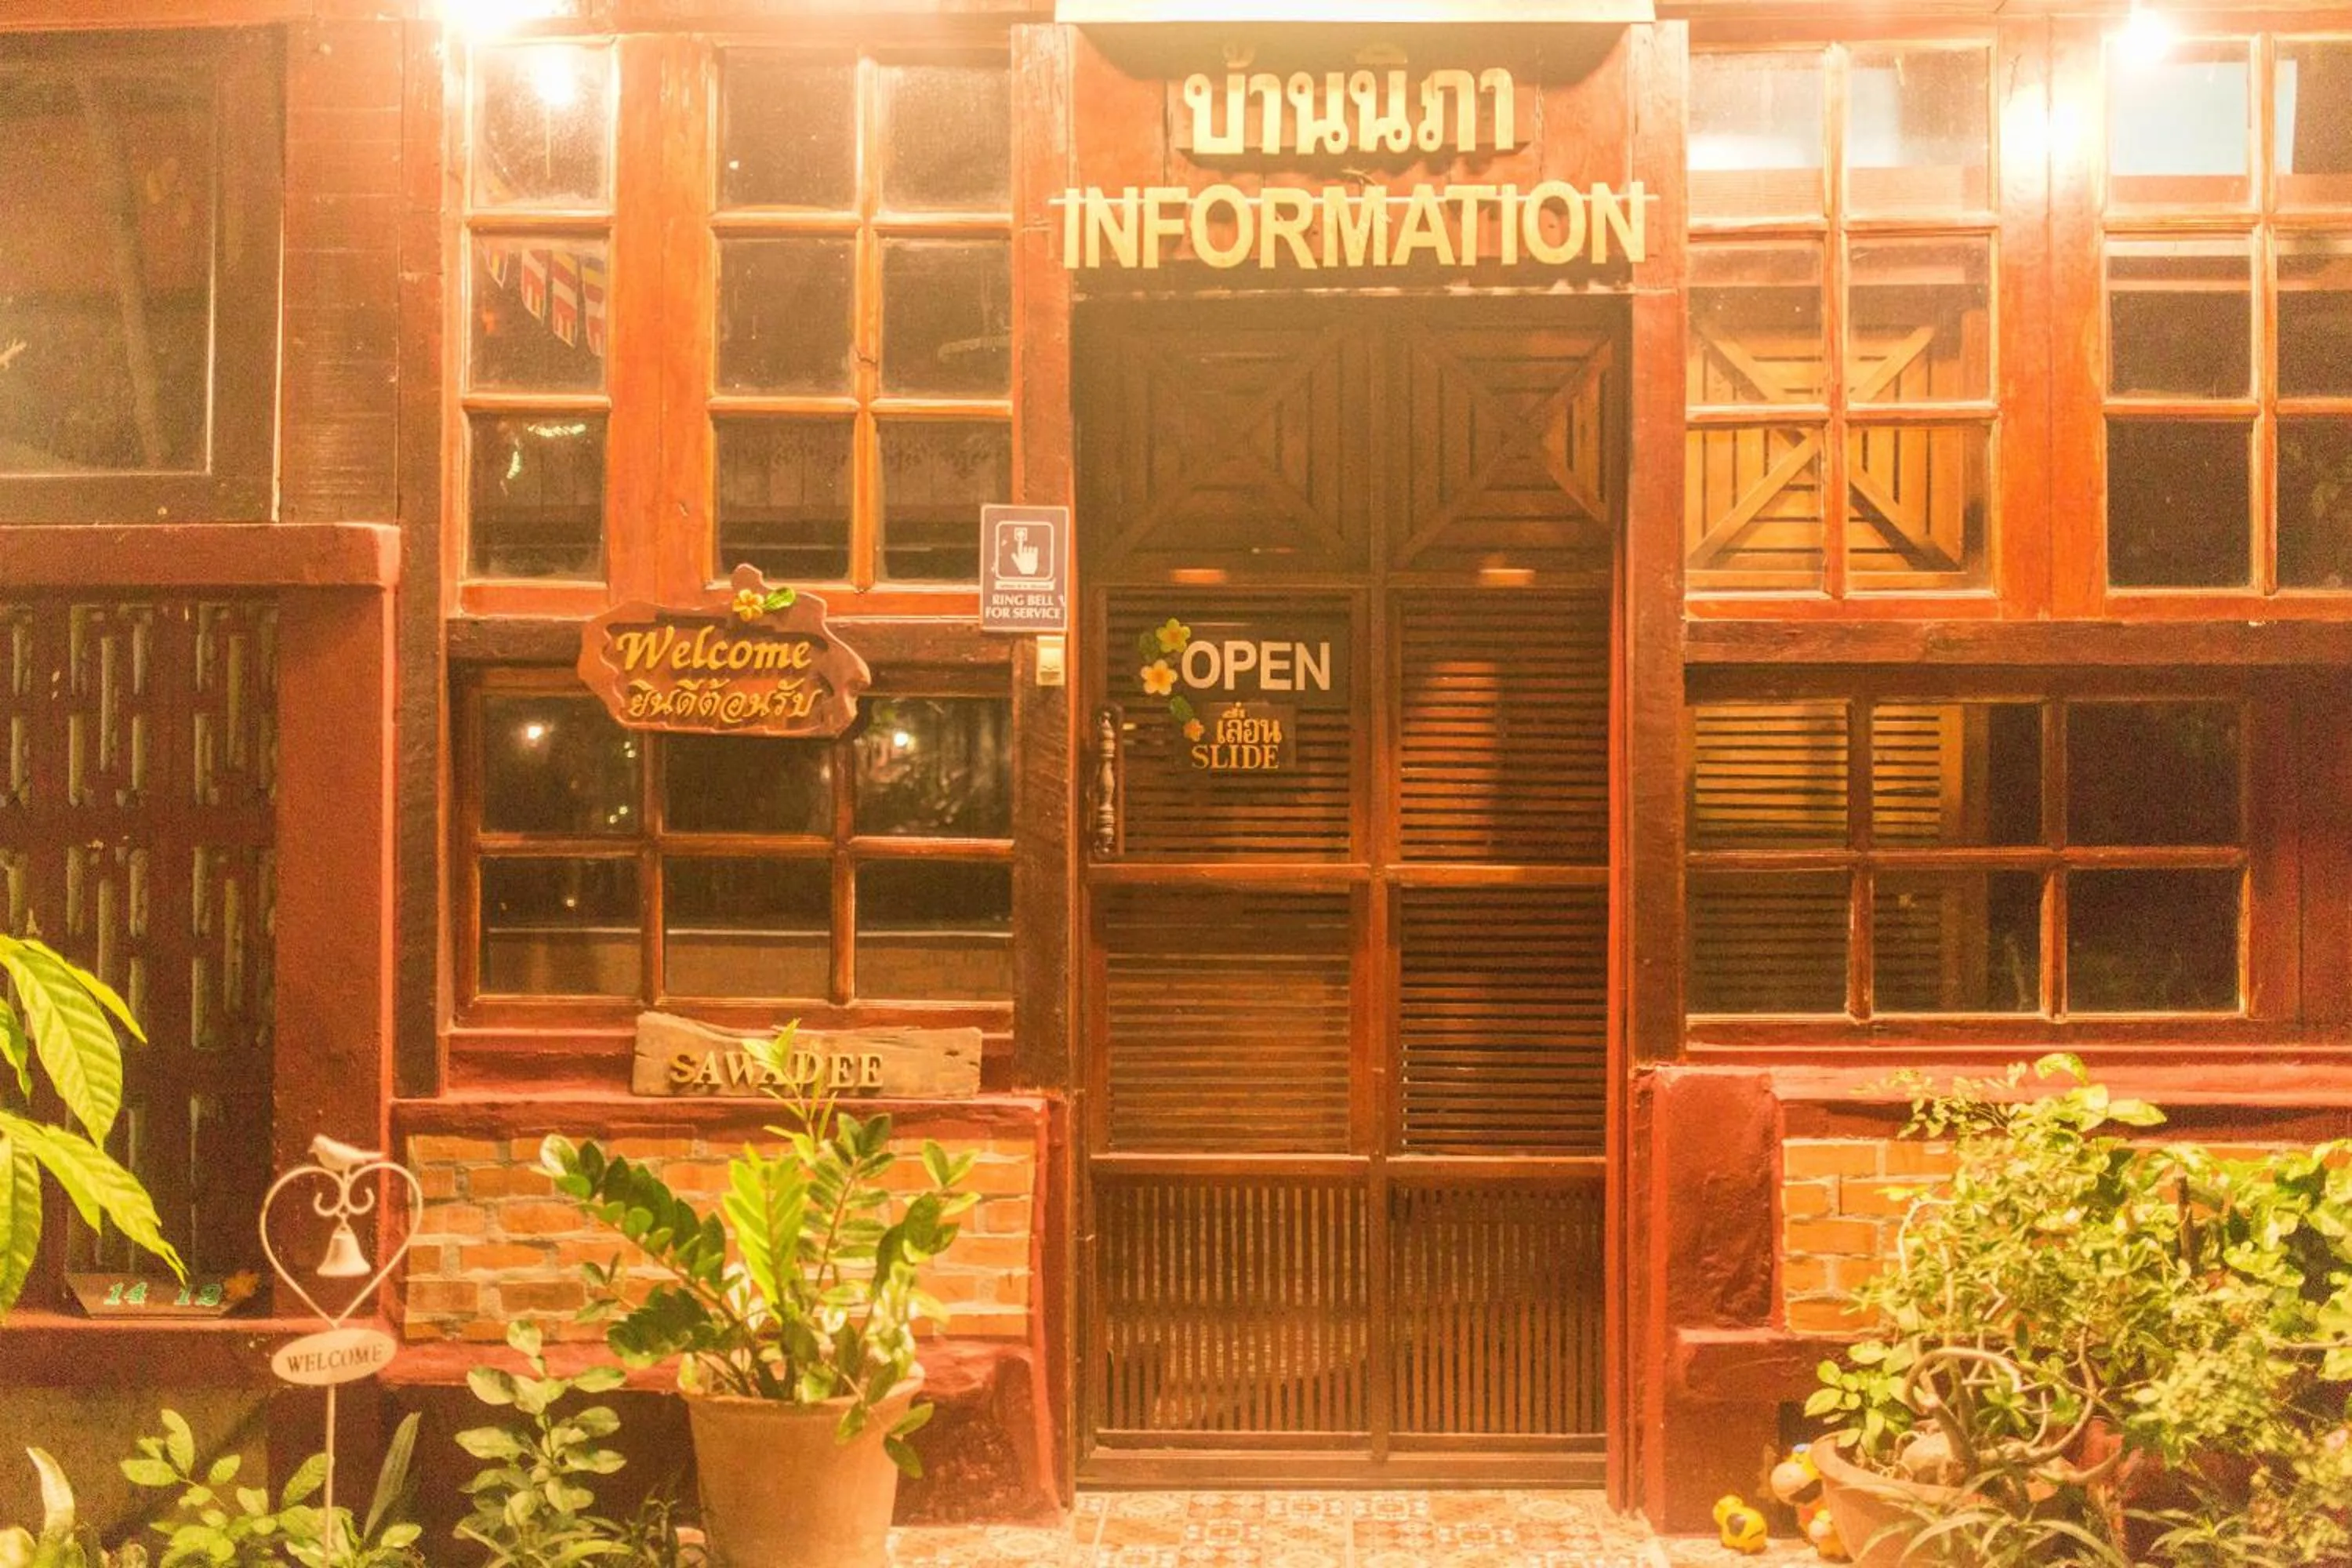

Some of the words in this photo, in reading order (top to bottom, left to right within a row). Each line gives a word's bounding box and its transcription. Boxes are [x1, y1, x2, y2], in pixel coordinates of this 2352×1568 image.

[1183, 42, 1515, 155] บ้านนิภา
[1062, 180, 1646, 270] INFORMATION
[985, 606, 1011, 619] FOR
[1012, 607, 1062, 619] SERVICE
[992, 594, 1025, 606] RING
[1027, 594, 1054, 607] BELL
[615, 625, 813, 671] Welcome
[1181, 641, 1330, 691] OPEN
[626, 677, 823, 724] ยินดีต้อนรับ
[1216, 702, 1283, 744] เลื่อน
[1191, 744, 1279, 769] SLIDE
[103, 1281, 148, 1305] 14
[286, 1343, 384, 1374] WELCOME
